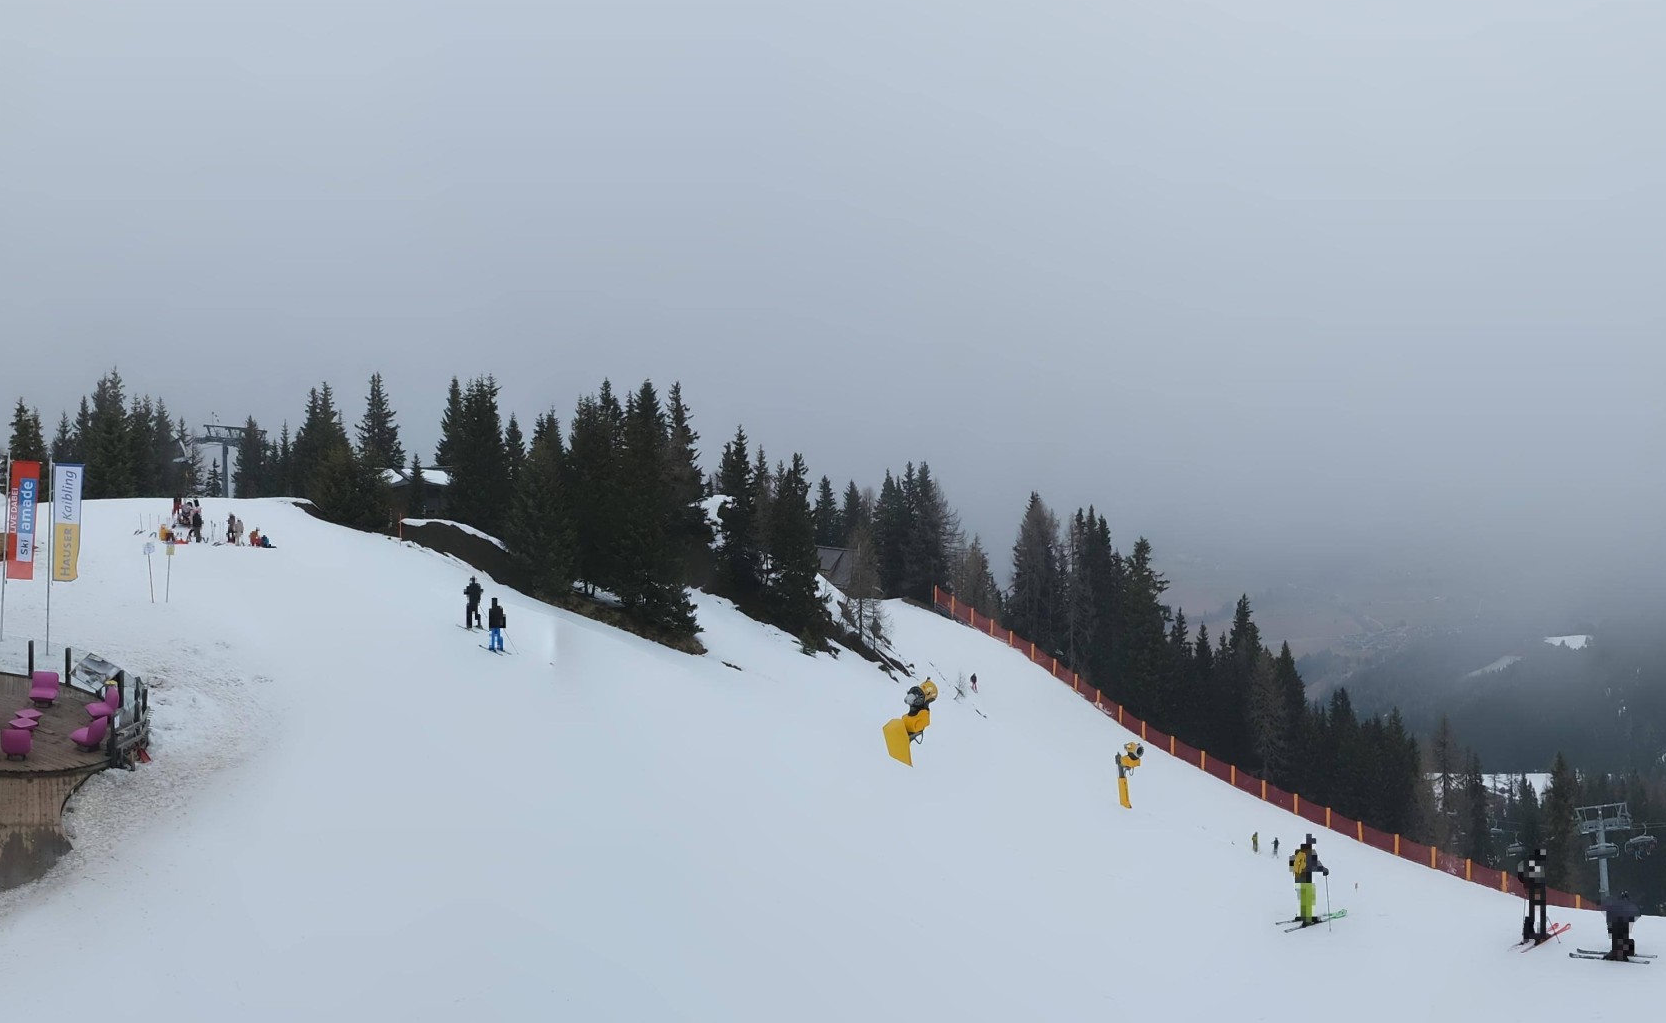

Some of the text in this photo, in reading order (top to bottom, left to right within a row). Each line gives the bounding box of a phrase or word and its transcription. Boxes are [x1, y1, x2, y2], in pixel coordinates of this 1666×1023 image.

[10, 487, 19, 534] LIVE DABEI
[61, 470, 77, 576] HAUSER Kaibling
[20, 539, 29, 556] Ski
